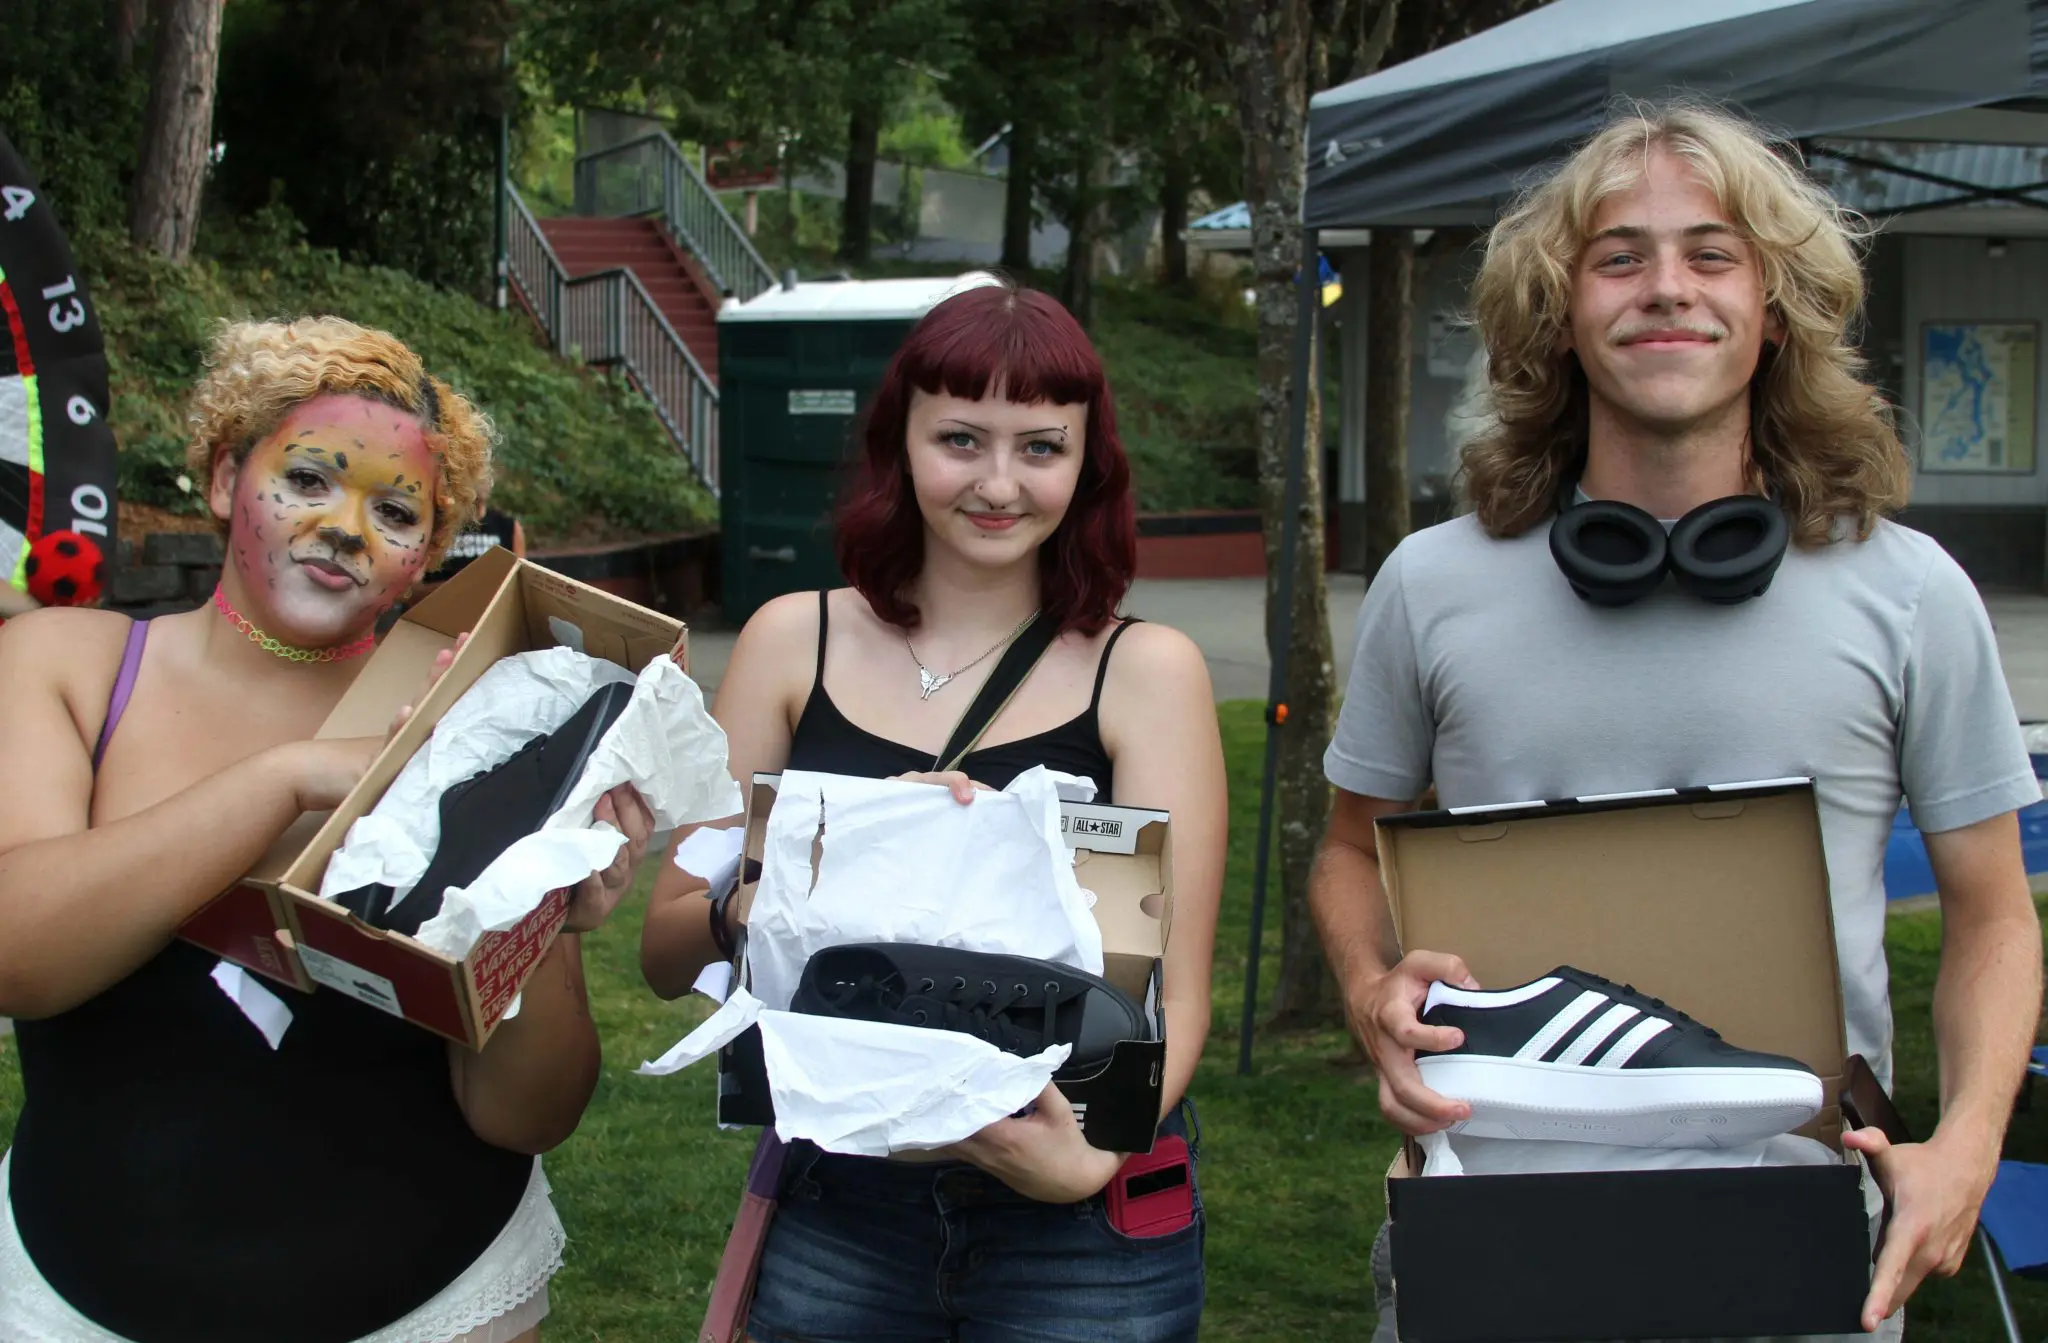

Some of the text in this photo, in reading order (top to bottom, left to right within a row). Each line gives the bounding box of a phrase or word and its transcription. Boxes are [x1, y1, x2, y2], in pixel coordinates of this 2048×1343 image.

[1, 185, 36, 222] 4
[42, 274, 86, 333] 13
[71, 484, 108, 537] 10
[1076, 820, 1119, 835] ALL STAR
[522, 896, 557, 943] VANS
[482, 931, 520, 981] VANS
[499, 938, 536, 988] VANS
